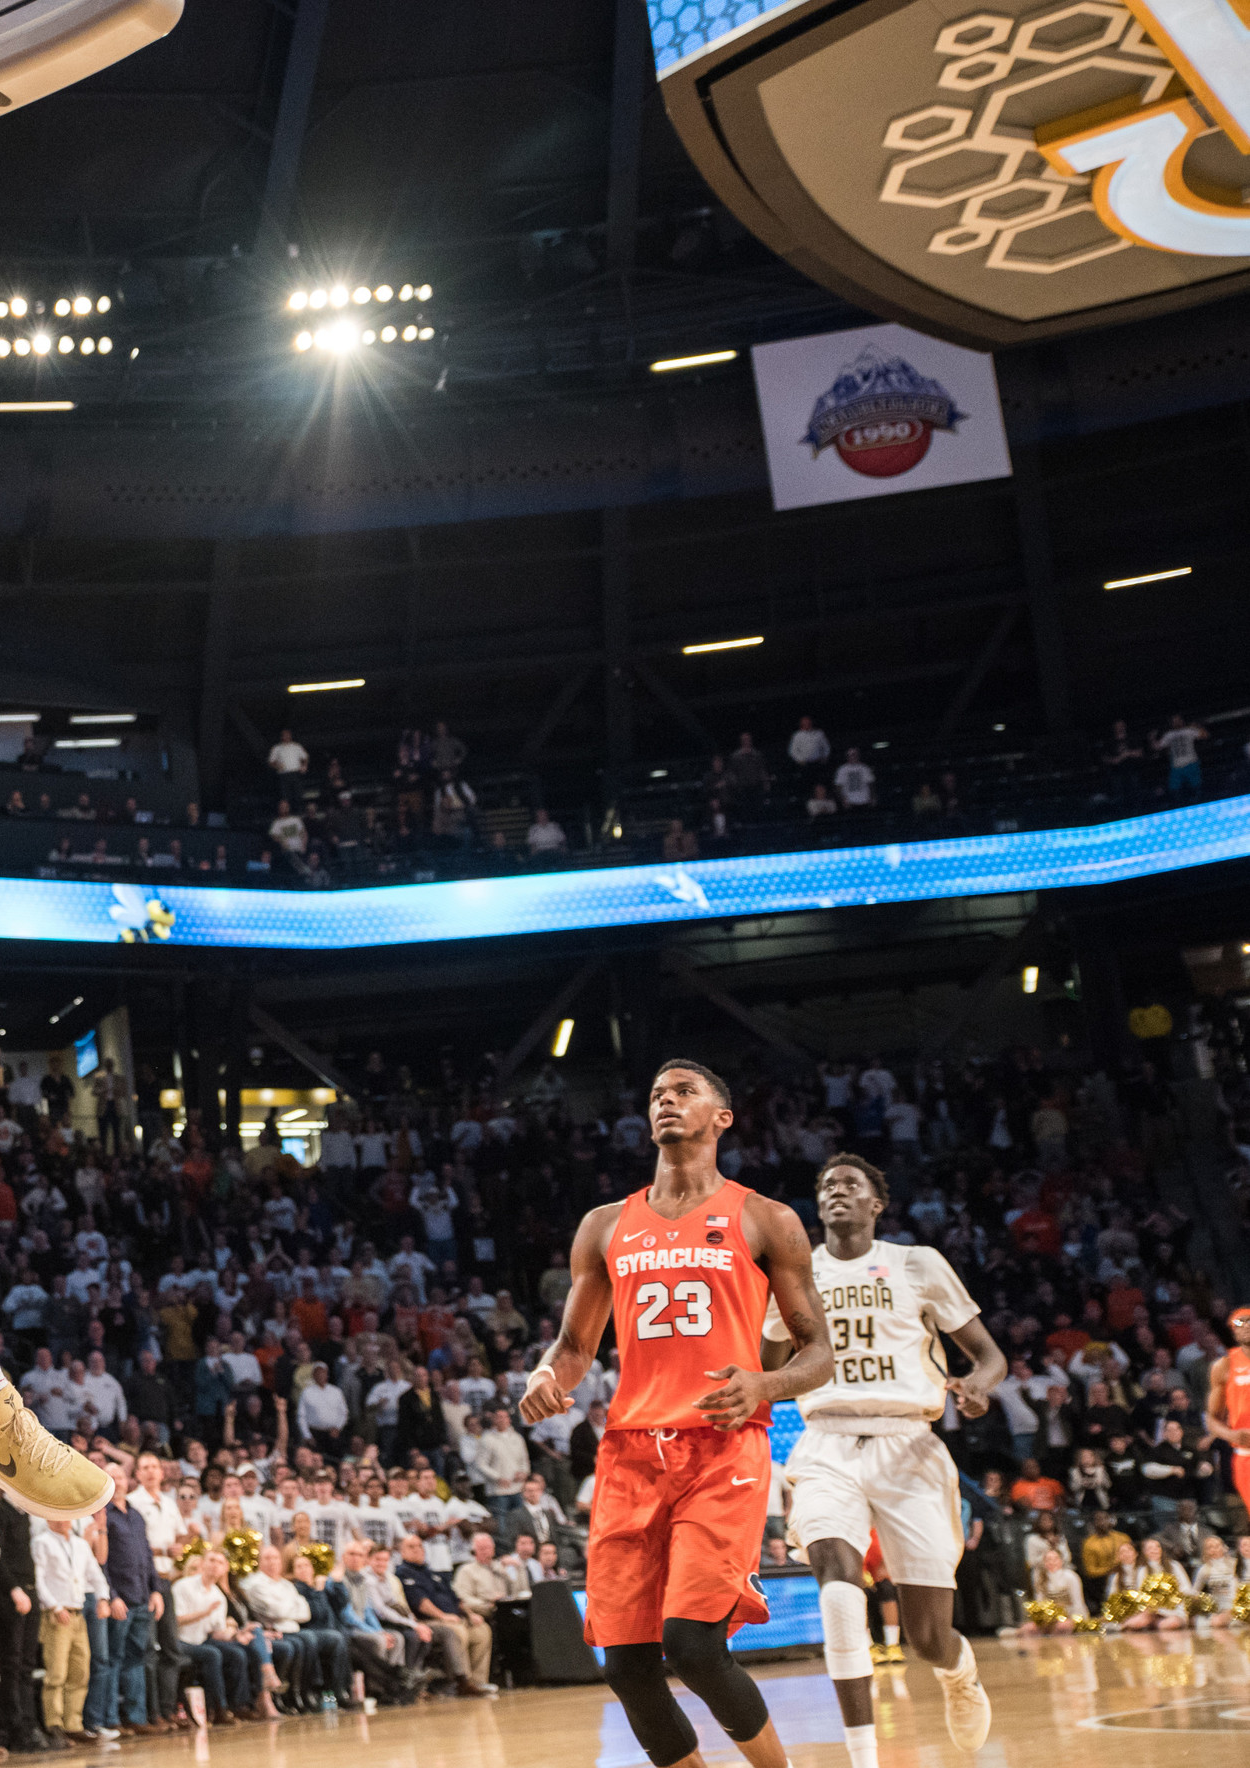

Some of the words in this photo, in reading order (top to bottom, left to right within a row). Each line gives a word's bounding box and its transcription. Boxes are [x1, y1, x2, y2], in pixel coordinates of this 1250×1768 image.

[850, 420, 911, 446] 1990
[616, 1247, 734, 1278] SYRACUSE
[636, 1280, 713, 1341] 23
[821, 1284, 895, 1314] EORGIA
[833, 1315, 876, 1352] 34
